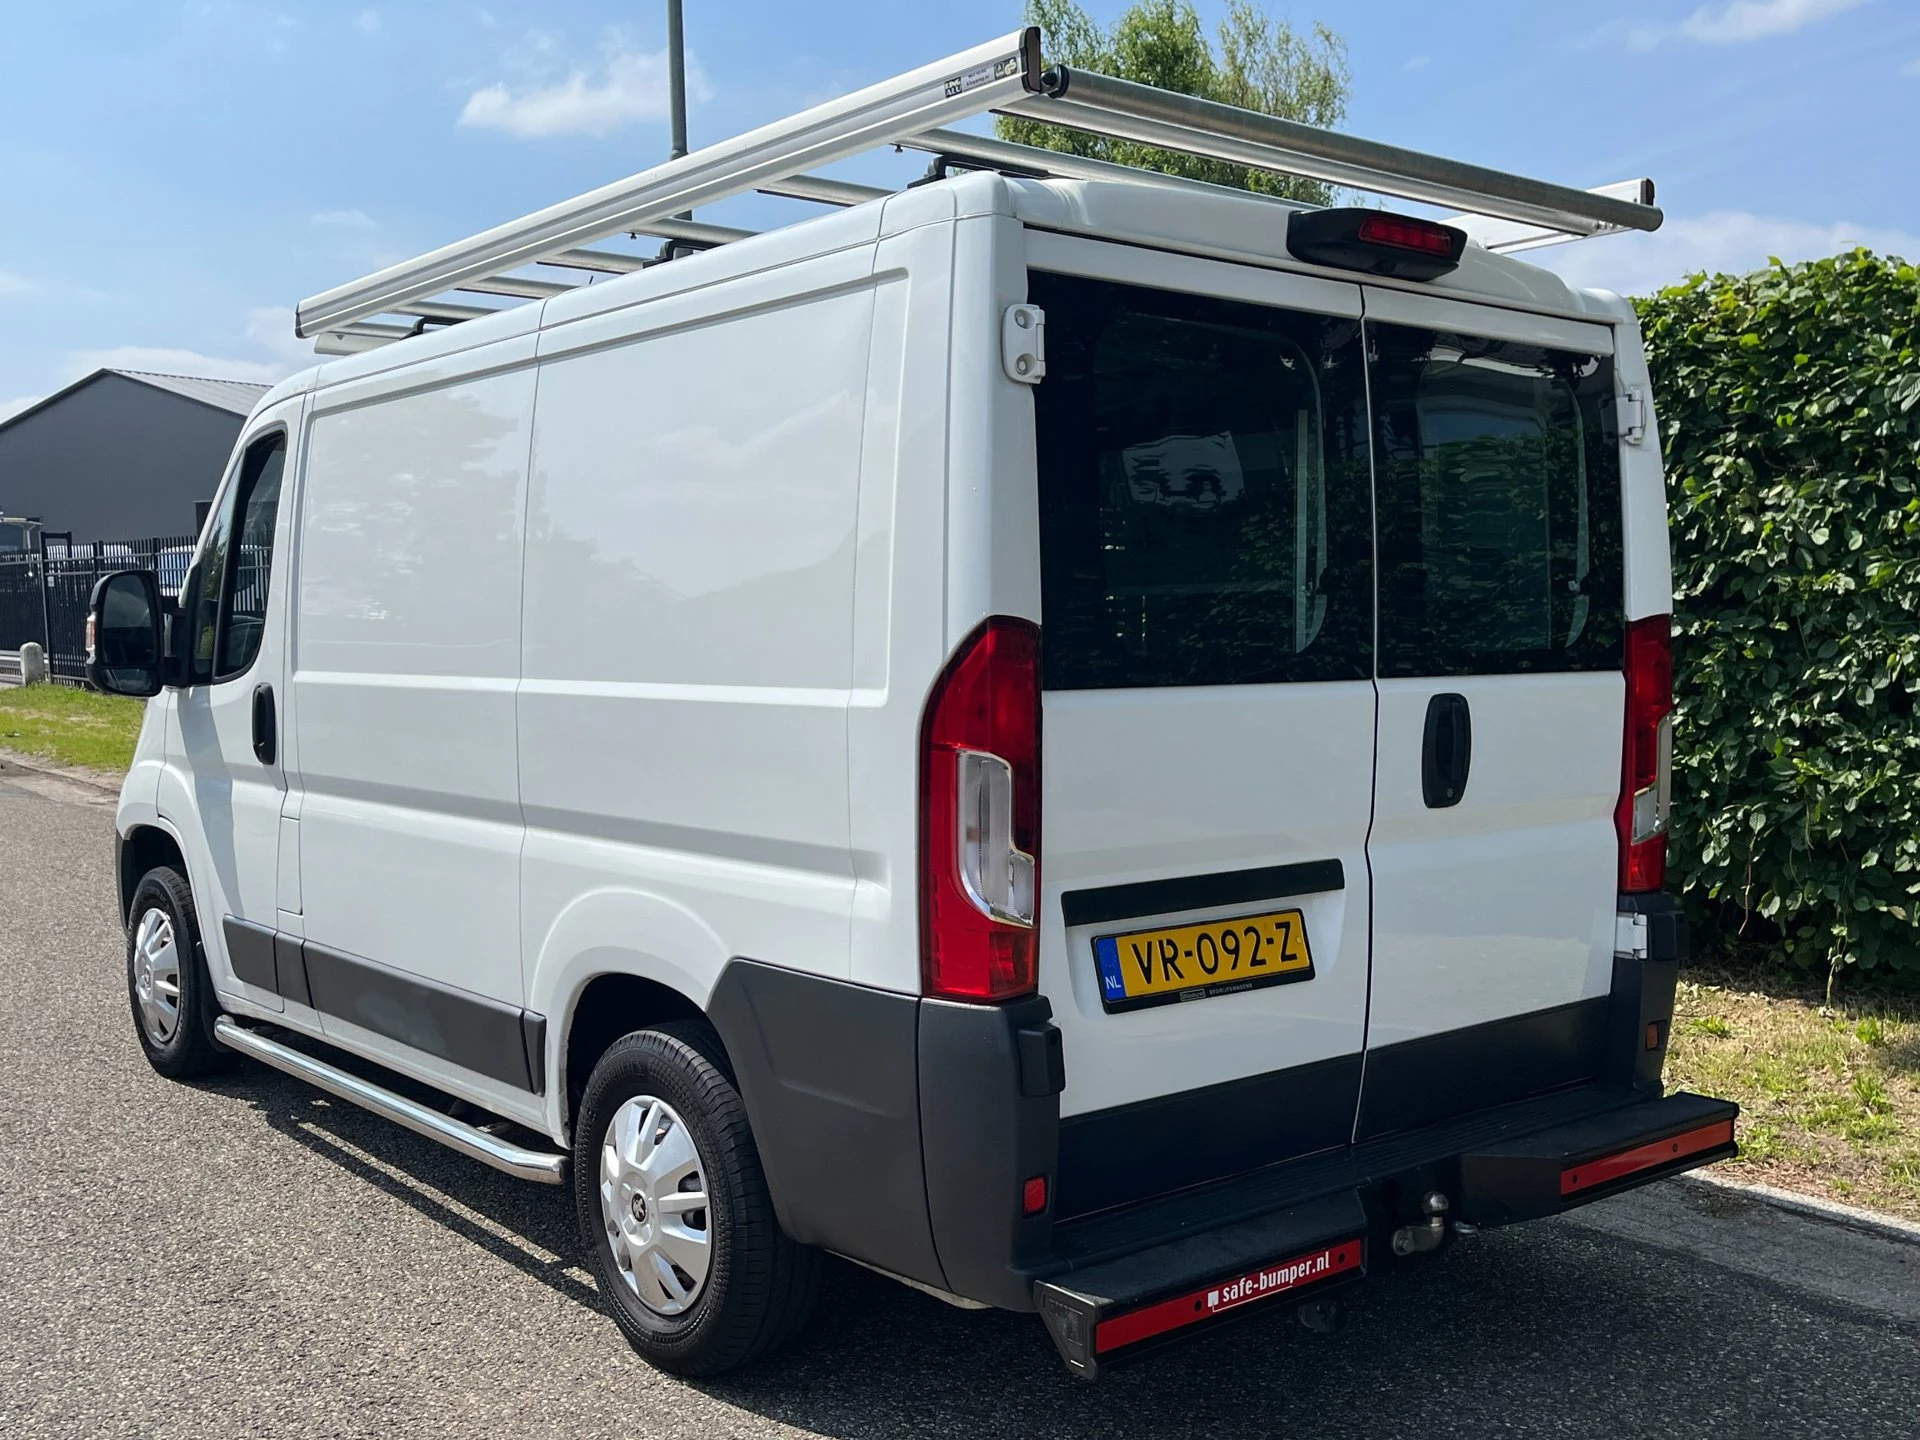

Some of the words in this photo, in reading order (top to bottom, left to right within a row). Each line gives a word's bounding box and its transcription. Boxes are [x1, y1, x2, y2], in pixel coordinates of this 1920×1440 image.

[946, 86, 962, 96] ALU
[1131, 921, 1298, 985] VR-092-Z
[1105, 976, 1122, 990] NL
[1222, 1251, 1330, 1303] safe-bumper.nl
